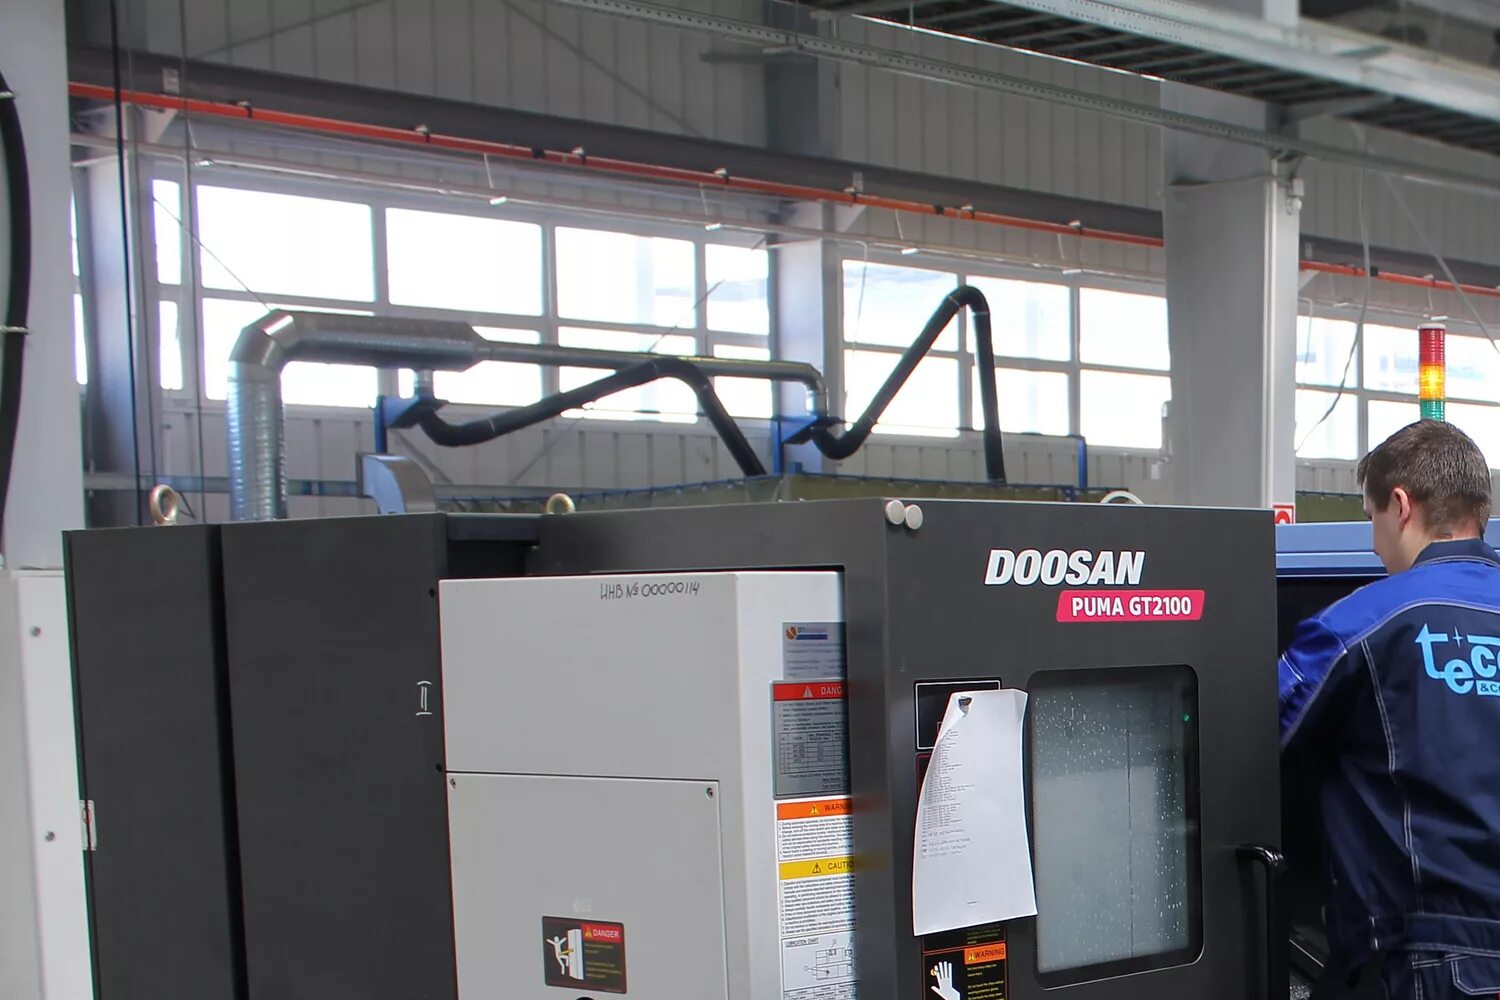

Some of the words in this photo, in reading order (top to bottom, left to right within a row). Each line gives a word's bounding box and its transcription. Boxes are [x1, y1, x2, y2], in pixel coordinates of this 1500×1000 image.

[984, 549, 1145, 585] DOOSAN
[641, 581, 700, 597] 00000114
[1072, 597, 1125, 617] PUMA
[1129, 596, 1192, 616] GT2100
[820, 686, 843, 695] DANG
[824, 802, 849, 811] WARN
[828, 860, 854, 870] CAUTIO
[592, 928, 620, 938] DANGER
[975, 948, 1004, 958] WARNING
